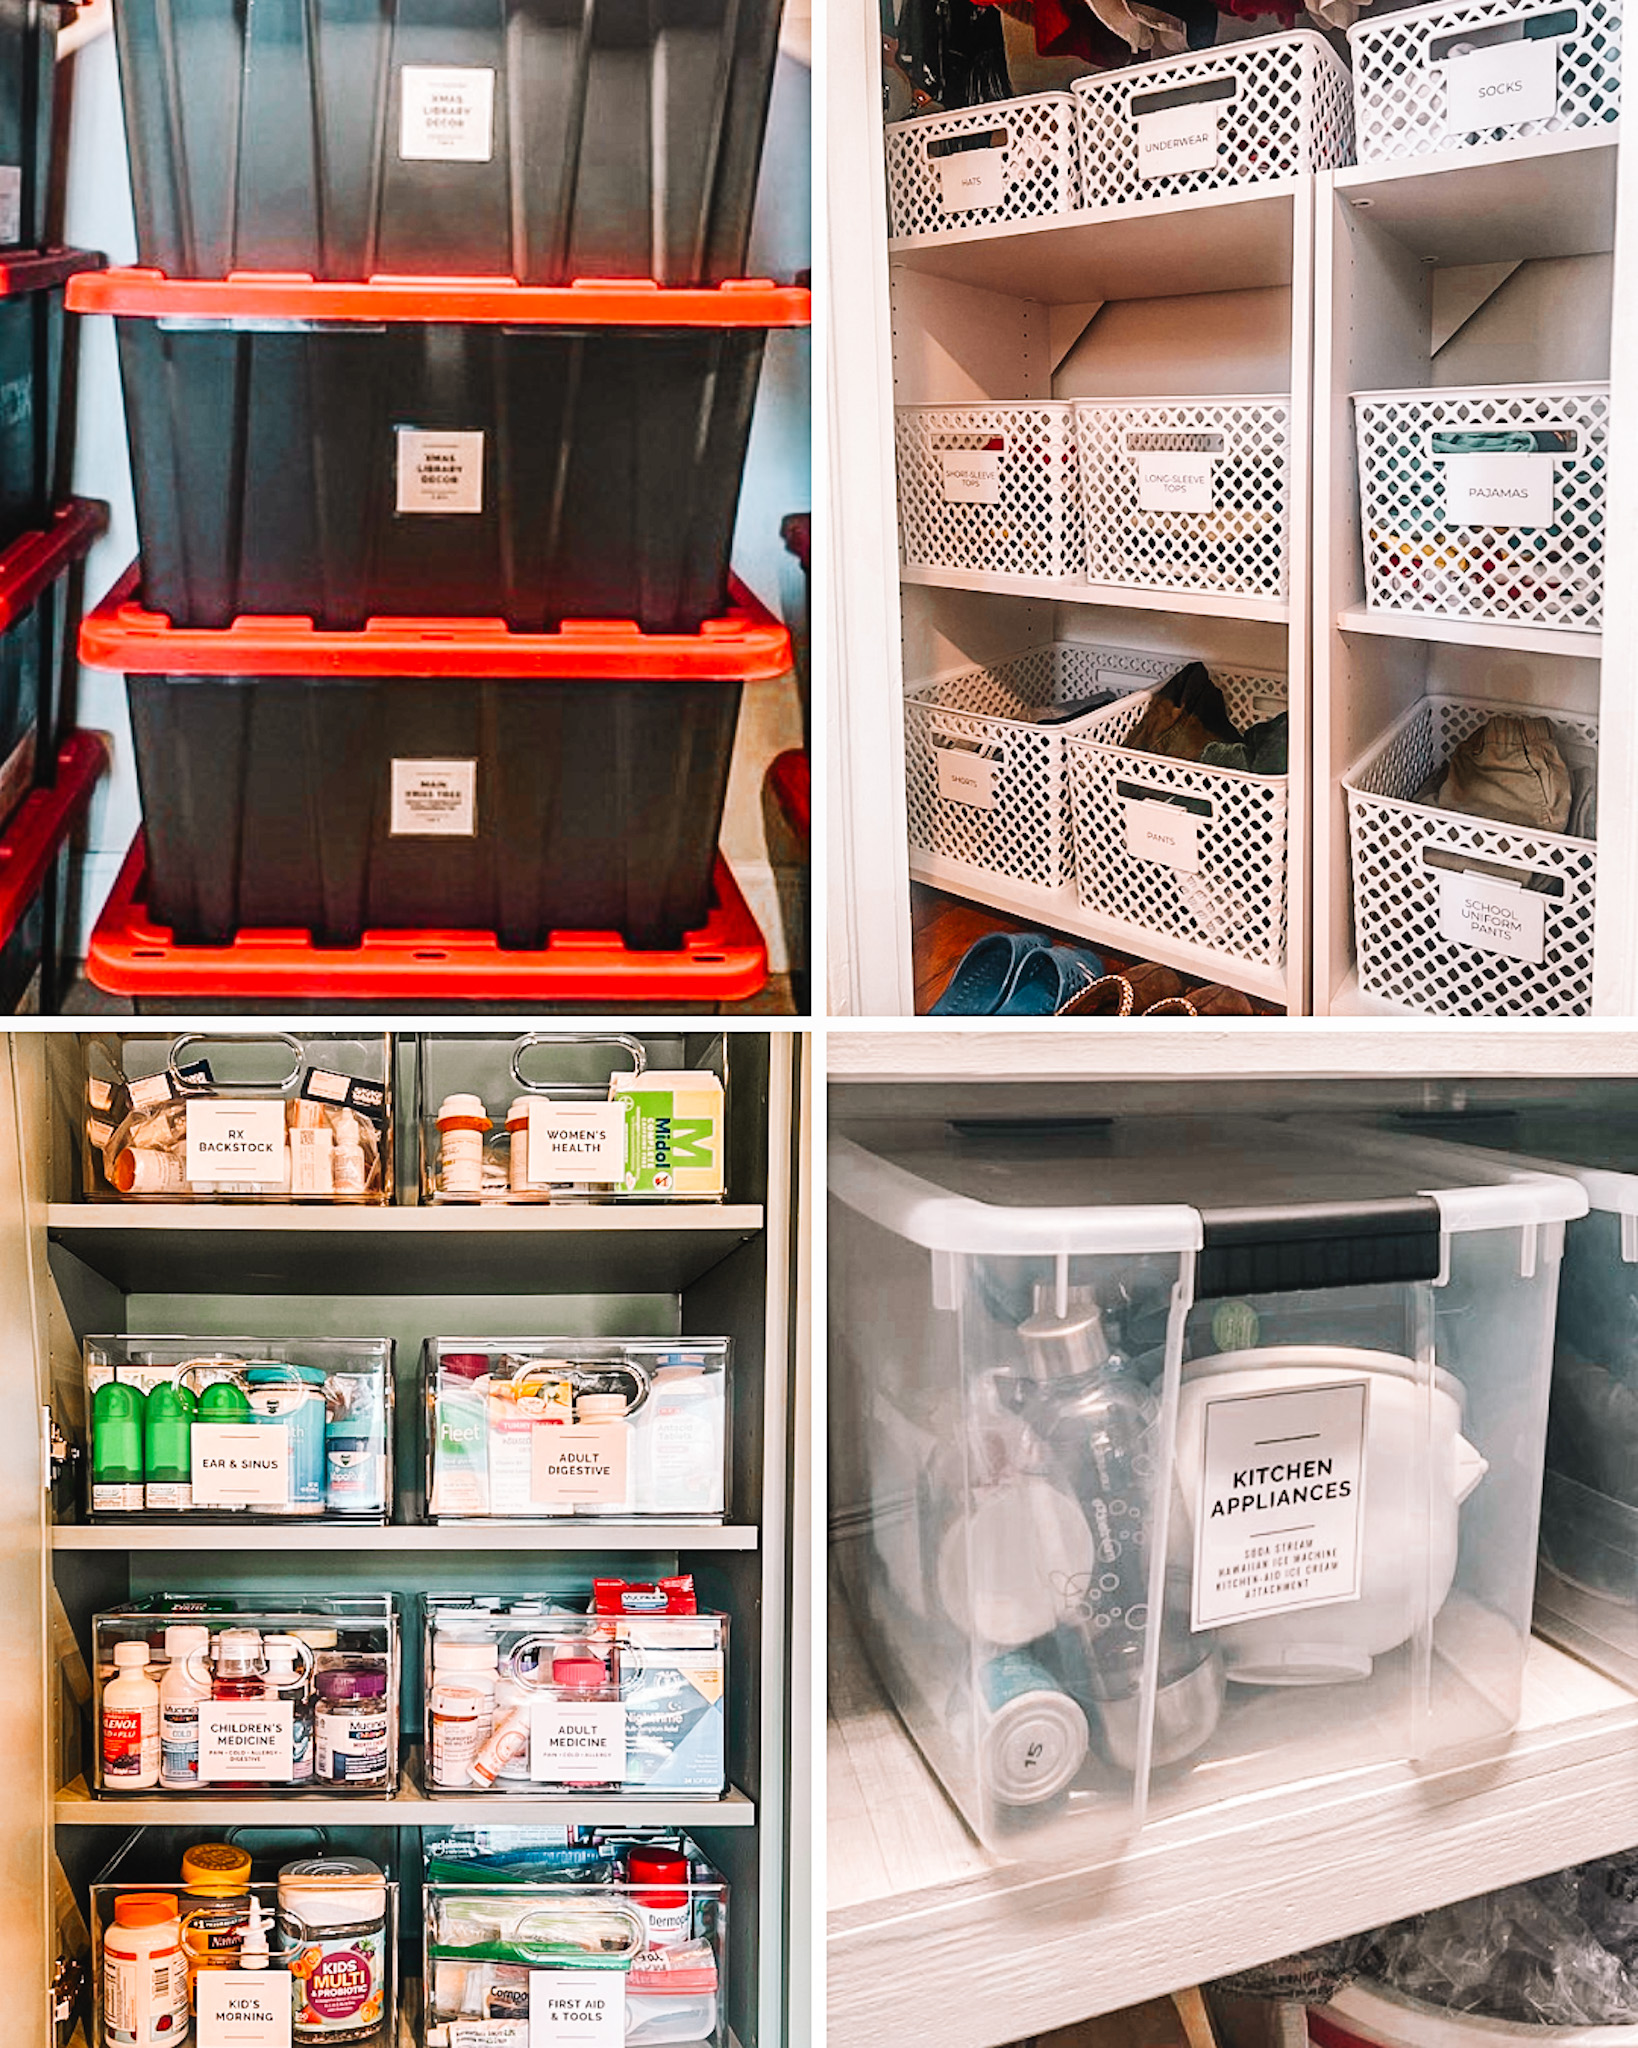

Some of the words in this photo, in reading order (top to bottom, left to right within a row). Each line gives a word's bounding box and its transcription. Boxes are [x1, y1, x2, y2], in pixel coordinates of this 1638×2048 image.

[1478, 80, 1523, 98] SOCKS
[1145, 133, 1209, 153] UNDERWEAR
[961, 177, 982, 187] HATS
[945, 469, 995, 480] SHORT-SLEEVE
[1144, 473, 1205, 485] LONG-SLEEVE
[961, 479, 981, 488] TOPS
[1163, 484, 1188, 494] TOPS
[1469, 488, 1529, 499] PAJAMAS
[951, 774, 978, 788] SHORTS
[1147, 832, 1176, 846] PANTS
[1464, 899, 1519, 921] SCHOOL
[1461, 908, 1522, 932] UNIFORM
[1471, 922, 1512, 941] PANTS
[228, 1129, 244, 1140] RX
[547, 1129, 607, 1140] WOMEN'S
[199, 1142, 274, 1153] BACKSTOCK
[552, 1143, 601, 1153] HEALTH
[655, 1117, 671, 1168] Midol
[440, 1422, 481, 1442] Fleet
[559, 1453, 600, 1463] ADULT
[202, 1459, 225, 1470] EAR
[229, 1459, 238, 1470] &
[241, 1459, 279, 1470] SINUS
[548, 1465, 610, 1476] DIGESTIVE
[1233, 1457, 1333, 1488] KITCHEN
[1210, 1480, 1352, 1518] APPLIANCES
[1244, 1546, 1270, 1559] SODA
[1275, 1539, 1313, 1553] STREAM
[1218, 1560, 1268, 1577] HAWAIIAN
[1272, 1556, 1289, 1567] ICE
[1293, 1548, 1337, 1563] MACHINE
[1284, 1566, 1300, 1578] ICE
[1305, 1561, 1338, 1575] CREAM
[1244, 1578, 1309, 1599] ATTACHMENT
[210, 1723, 283, 1733] CHILDREN'S
[558, 1726, 598, 1735] ADULT
[218, 1736, 276, 1746] MEDICINE
[549, 1738, 607, 1747] MEDICINE
[322, 1959, 358, 1975] KIDS
[313, 1970, 365, 1990] MULTI
[317, 1983, 368, 1998] PROBIOTIC
[228, 1999, 260, 2009] KID'S
[548, 1999, 582, 2009] FIRST
[585, 1999, 606, 2009] AID
[216, 2012, 274, 2022] MORNING
[550, 2012, 559, 2022] &
[564, 2012, 602, 2022] TOOLS
